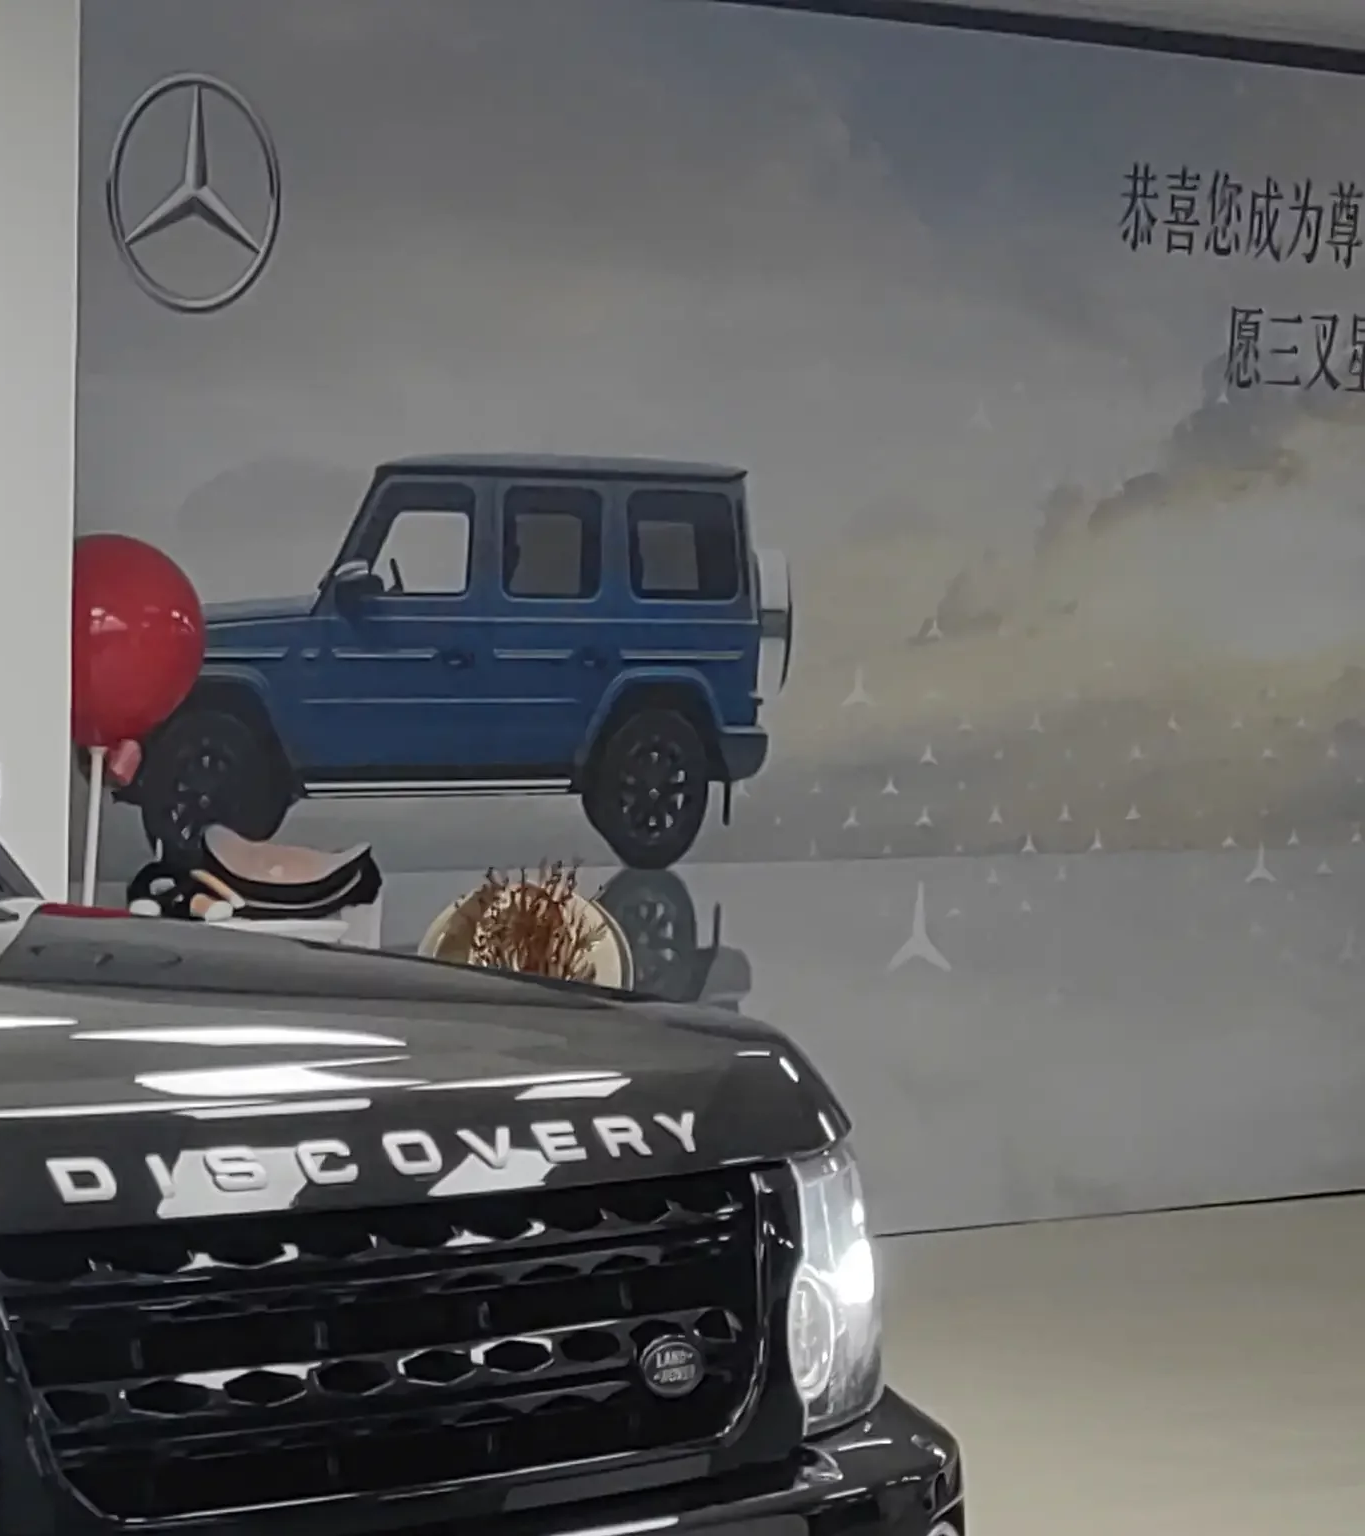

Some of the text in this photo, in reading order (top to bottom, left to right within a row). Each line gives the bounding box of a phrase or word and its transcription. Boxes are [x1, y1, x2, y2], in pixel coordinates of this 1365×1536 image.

[1120, 162, 1364, 269] 恭喜您成为尊
[46, 1111, 697, 1203] DISCOVERY
